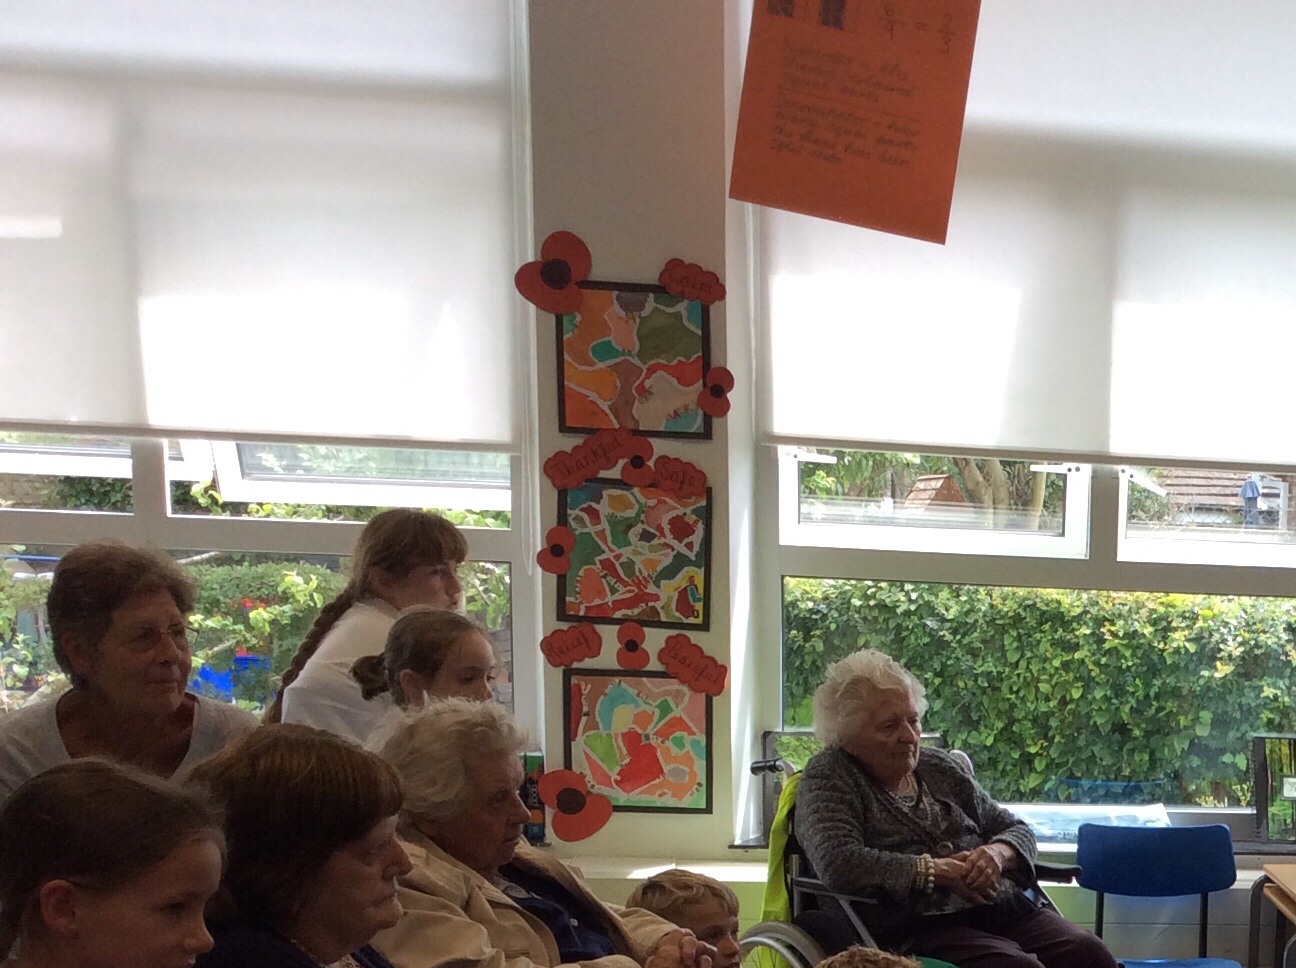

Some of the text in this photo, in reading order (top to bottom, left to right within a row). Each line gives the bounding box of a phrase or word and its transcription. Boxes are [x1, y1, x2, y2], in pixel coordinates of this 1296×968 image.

[549, 435, 623, 476] Thankful
[659, 460, 696, 491] Safe
[545, 627, 593, 660] Relief
[670, 640, 724, 683] Peaceful
